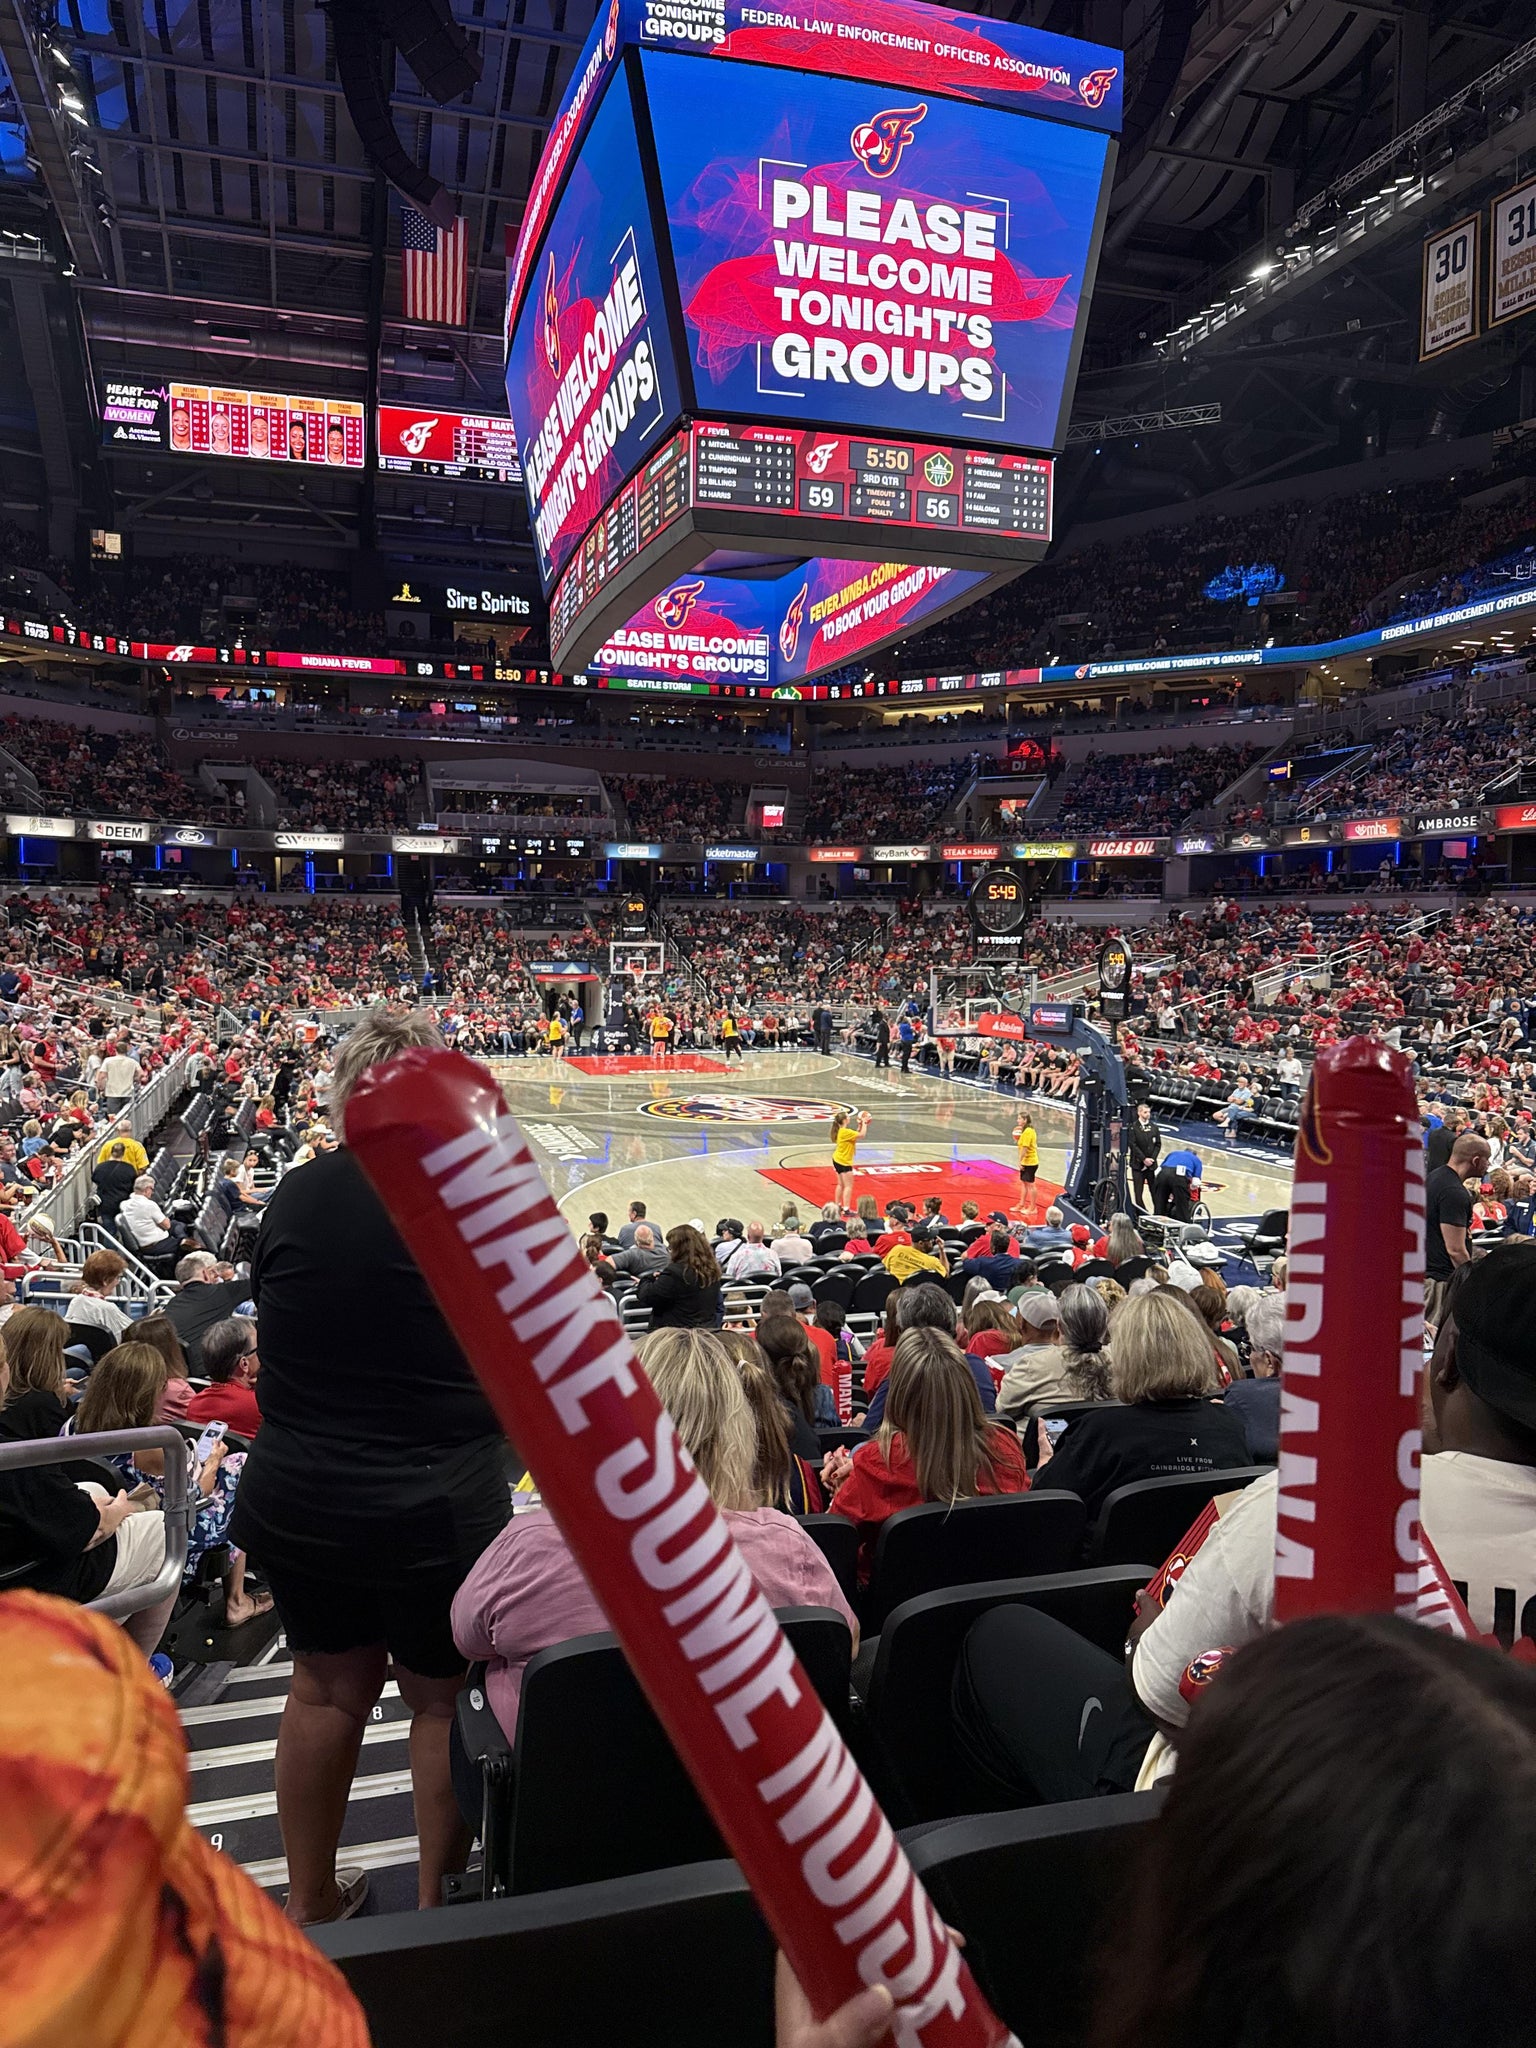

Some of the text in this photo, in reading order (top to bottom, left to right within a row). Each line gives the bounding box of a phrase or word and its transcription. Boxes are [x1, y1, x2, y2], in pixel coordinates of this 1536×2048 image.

[645, 3, 725, 26] TONIGHT'S
[645, 18, 726, 44] GROUPS
[741, 8, 1071, 86] FEDERAL LAW ENFORCEMENT OFFICERS ASSOCIATION
[563, 39, 603, 144] ASSOCIATION
[772, 179, 996, 261] PLEASE
[1508, 196, 1536, 246] 31
[1435, 234, 1467, 284] 30
[774, 240, 993, 306] WELCOME
[1502, 297, 1516, 310] HALL
[774, 287, 993, 350] TONIGHT'S
[1431, 322, 1466, 344] HALL FAME
[771, 332, 994, 401] GROUPS
[526, 402, 563, 508] PLEASE
[556, 255, 644, 437] WELCOME
[106, 384, 144, 396] HEART
[107, 396, 159, 409] CARE FOR
[108, 409, 151, 422] WOMEN
[461, 418, 489, 429] GAME
[708, 427, 729, 436] FEVER
[535, 441, 587, 558] TONIGHT'S
[583, 340, 654, 476] GROUPS
[708, 440, 739, 450] MITCHELL
[708, 453, 751, 463] CUNNINGHAM
[866, 447, 909, 471] 5:50
[973, 456, 995, 465] STORM
[708, 466, 737, 475] TIMPSON
[708, 478, 736, 488] BILLINGS
[863, 474, 899, 486] 3RD QTR
[974, 481, 1000, 490] JOHNSON
[708, 491, 731, 500] HARRIS
[808, 486, 834, 507] 59
[866, 489, 905, 500] TIMEOUTS 3
[973, 492, 986, 500] FAM
[871, 498, 890, 507] FOULS
[926, 498, 950, 519] 56
[867, 508, 893, 517] PENALTY
[973, 504, 1000, 514] MALONGA
[973, 516, 999, 525] HORSTON
[447, 589, 530, 614] Sire Spirits
[821, 621, 835, 641] TO
[836, 604, 863, 636] BOOK
[863, 588, 889, 620] YOUR
[891, 568, 926, 604] GROUP
[1381, 590, 1536, 641] FEDERAL LAW ENFORCEMENT OFFICERS
[24, 626, 49, 639] 19/39
[119, 645, 129, 654] 17
[668, 634, 766, 656] WELCOME
[302, 656, 371, 669] INDIANA FEVER
[594, 648, 767, 674] TONIGHT'S GROUPS
[1092, 651, 1260, 674] PLEASE WELCOME TONIGHT'S GROUPS
[418, 664, 433, 675] 59
[495, 669, 521, 681] 5:50
[573, 675, 587, 685] 56
[627, 679, 691, 691] SEATTLE STORM
[749, 688, 755, 696] 3
[853, 688, 863, 697] 14
[901, 683, 923, 693] 22/39
[191, 731, 238, 741] LEXUS
[769, 760, 806, 768] LEXUS
[1012, 761, 1027, 771] DJ
[1417, 815, 1478, 830] AMBROSE
[105, 826, 142, 838] DEEM
[1366, 823, 1387, 835] mhs
[181, 831, 199, 841] Ford
[1089, 840, 1156, 856] LUCAS OIL
[1182, 838, 1206, 852] xfinity
[570, 848, 580, 856] 56
[706, 847, 758, 859] ticketmaster
[874, 850, 910, 860] KeyBank
[943, 847, 998, 856] STEAK SHAKE
[1030, 848, 1059, 857] PUNCH
[988, 885, 1016, 900] 5:49
[990, 936, 1022, 945] TISSOT
[839, 1373, 852, 1415] MAKE
[420, 1113, 966, 2048] MAKE SOME NOISE
[372, 1705, 383, 1719] 8
[211, 1833, 223, 1850] 9
